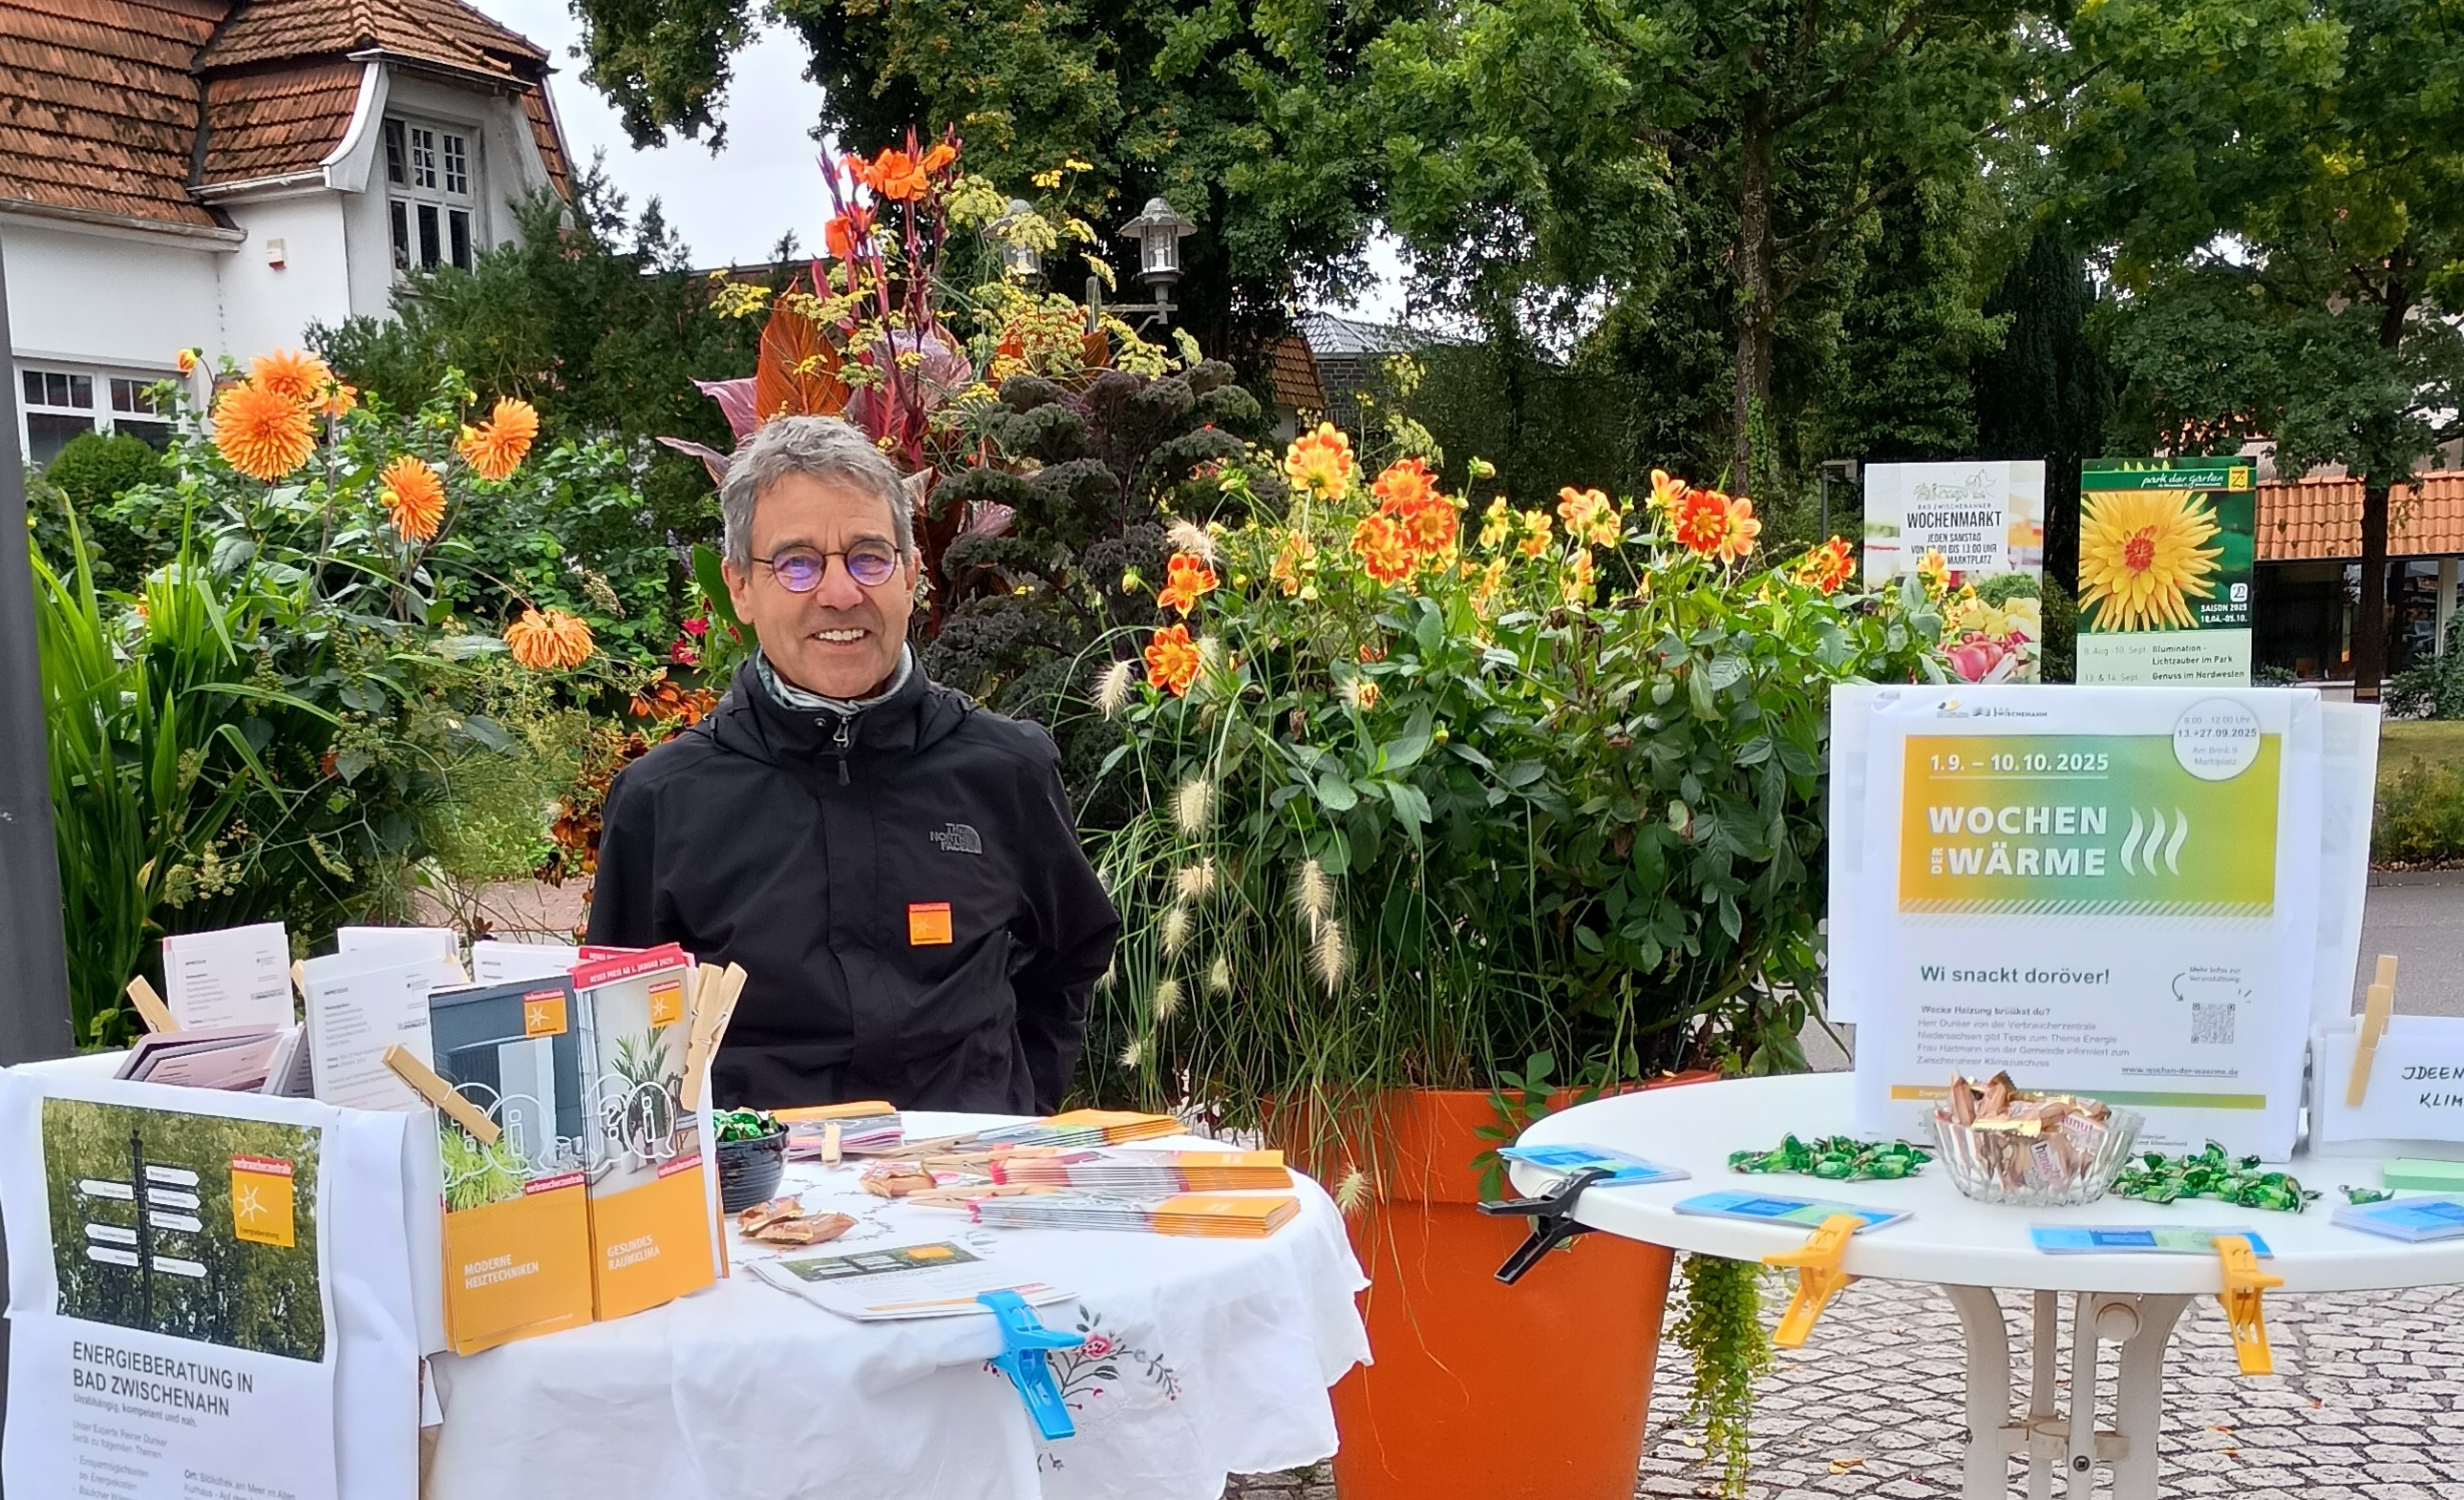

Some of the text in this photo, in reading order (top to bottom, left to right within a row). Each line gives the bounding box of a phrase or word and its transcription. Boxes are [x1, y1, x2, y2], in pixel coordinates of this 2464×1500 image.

[2140, 473, 2167, 489] park
[1906, 511, 2003, 529] WOCHENMARKT
[1927, 532, 1982, 543] JEDEN SAMSTAG
[1911, 545, 1924, 555] VON
[1948, 545, 1960, 554] BIS
[1983, 543, 1997, 553] UHR
[1946, 555, 1992, 565] MARKTPLATZ
[2200, 603, 2228, 613] SAISON
[2152, 644, 2201, 653] Illumination
[2152, 655, 2233, 665] Lichtzauber im Park
[2152, 670, 2245, 681] Genuss im Nordwesten
[2235, 715, 2251, 725] Uhr
[1928, 805, 2108, 835] WOCHEN
[929, 831, 966, 842] NORTH
[1930, 846, 1944, 875] DER
[1946, 840, 2107, 877] WÄRME
[1921, 965, 2111, 985] Wi snackt doröver!
[1954, 1005, 1992, 1017] Heizung
[2032, 1007, 2050, 1016] du?
[606, 1234, 653, 1257] GESUNDES
[464, 1254, 512, 1276] MODERNE
[608, 1245, 661, 1271] RAUMKLIMA
[465, 1260, 540, 1289] HEIZTECHNIKEN
[73, 1341, 253, 1394] ENERGIEBERATUNG IN
[73, 1368, 230, 1417] BAD ZWISCHENAHN
[164, 1412, 181, 1424] und
